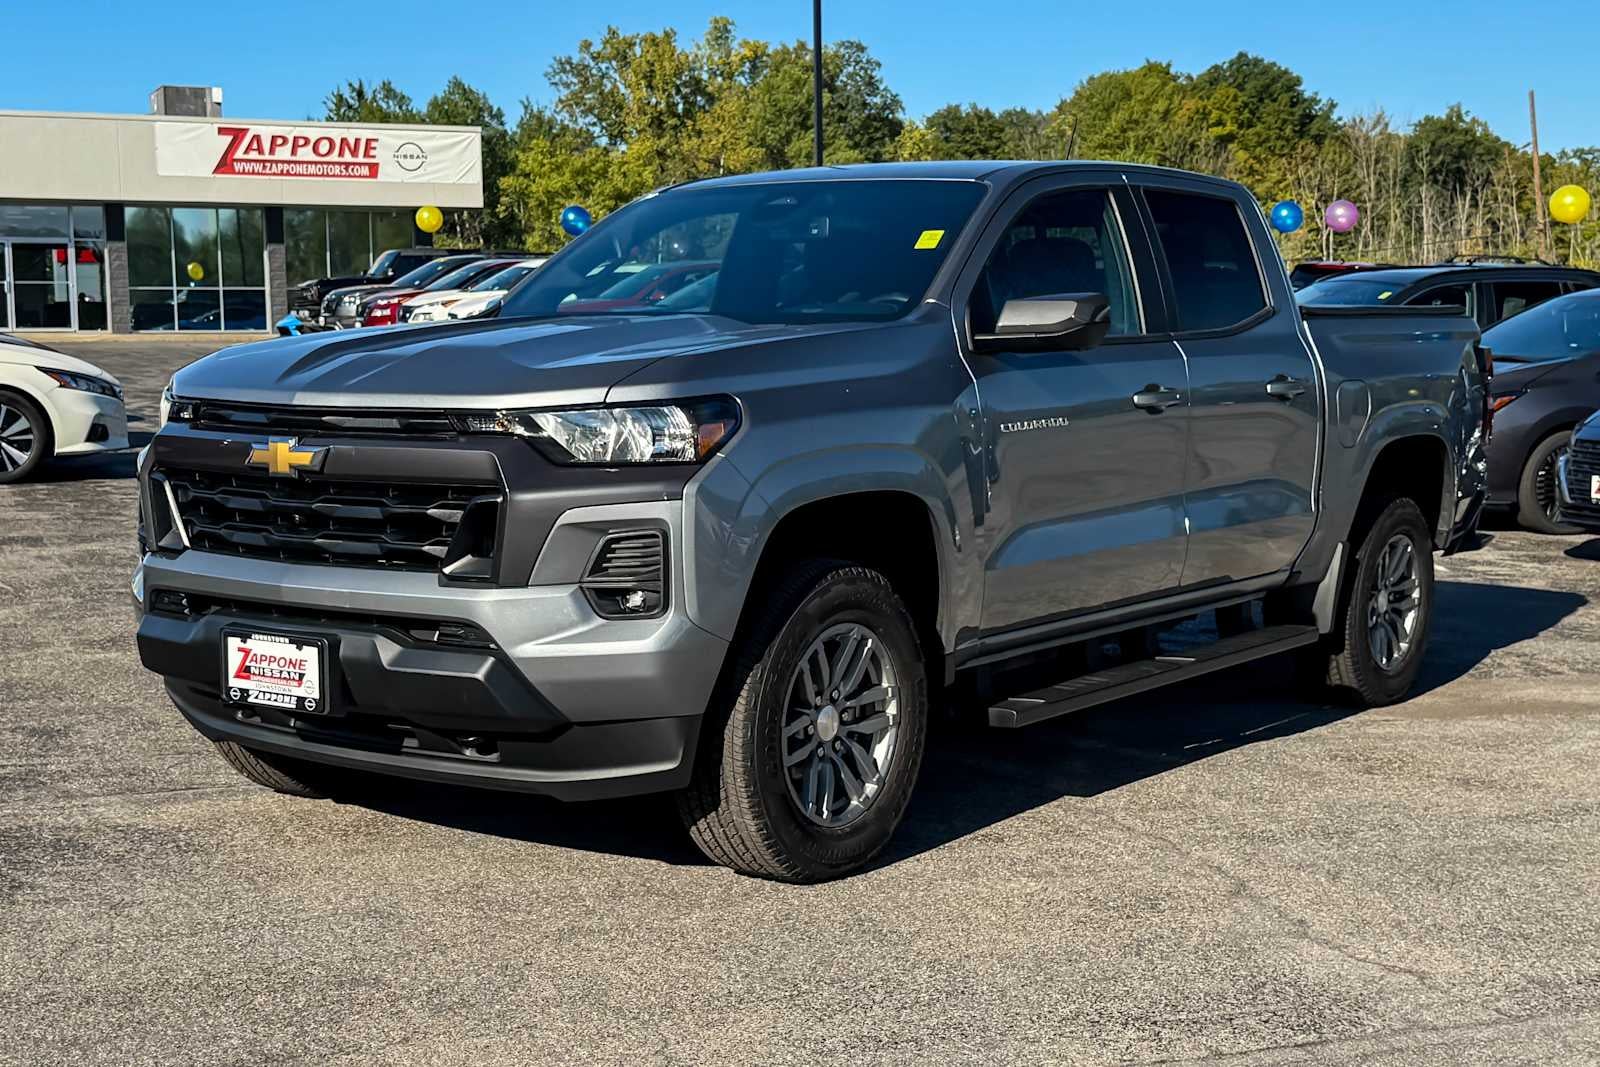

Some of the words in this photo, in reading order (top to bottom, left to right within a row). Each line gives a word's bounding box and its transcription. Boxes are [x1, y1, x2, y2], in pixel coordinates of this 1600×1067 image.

[212, 127, 379, 174] ZAPPONE
[393, 152, 427, 161] NISSAN
[233, 161, 369, 177] WWW.ZAPPONEMOTORS.COM
[1000, 417, 1069, 433] COLORADO
[233, 647, 308, 680] ZAPPONE
[250, 666, 299, 680] NISSAN
[247, 690, 298, 706] ZAPPONE
